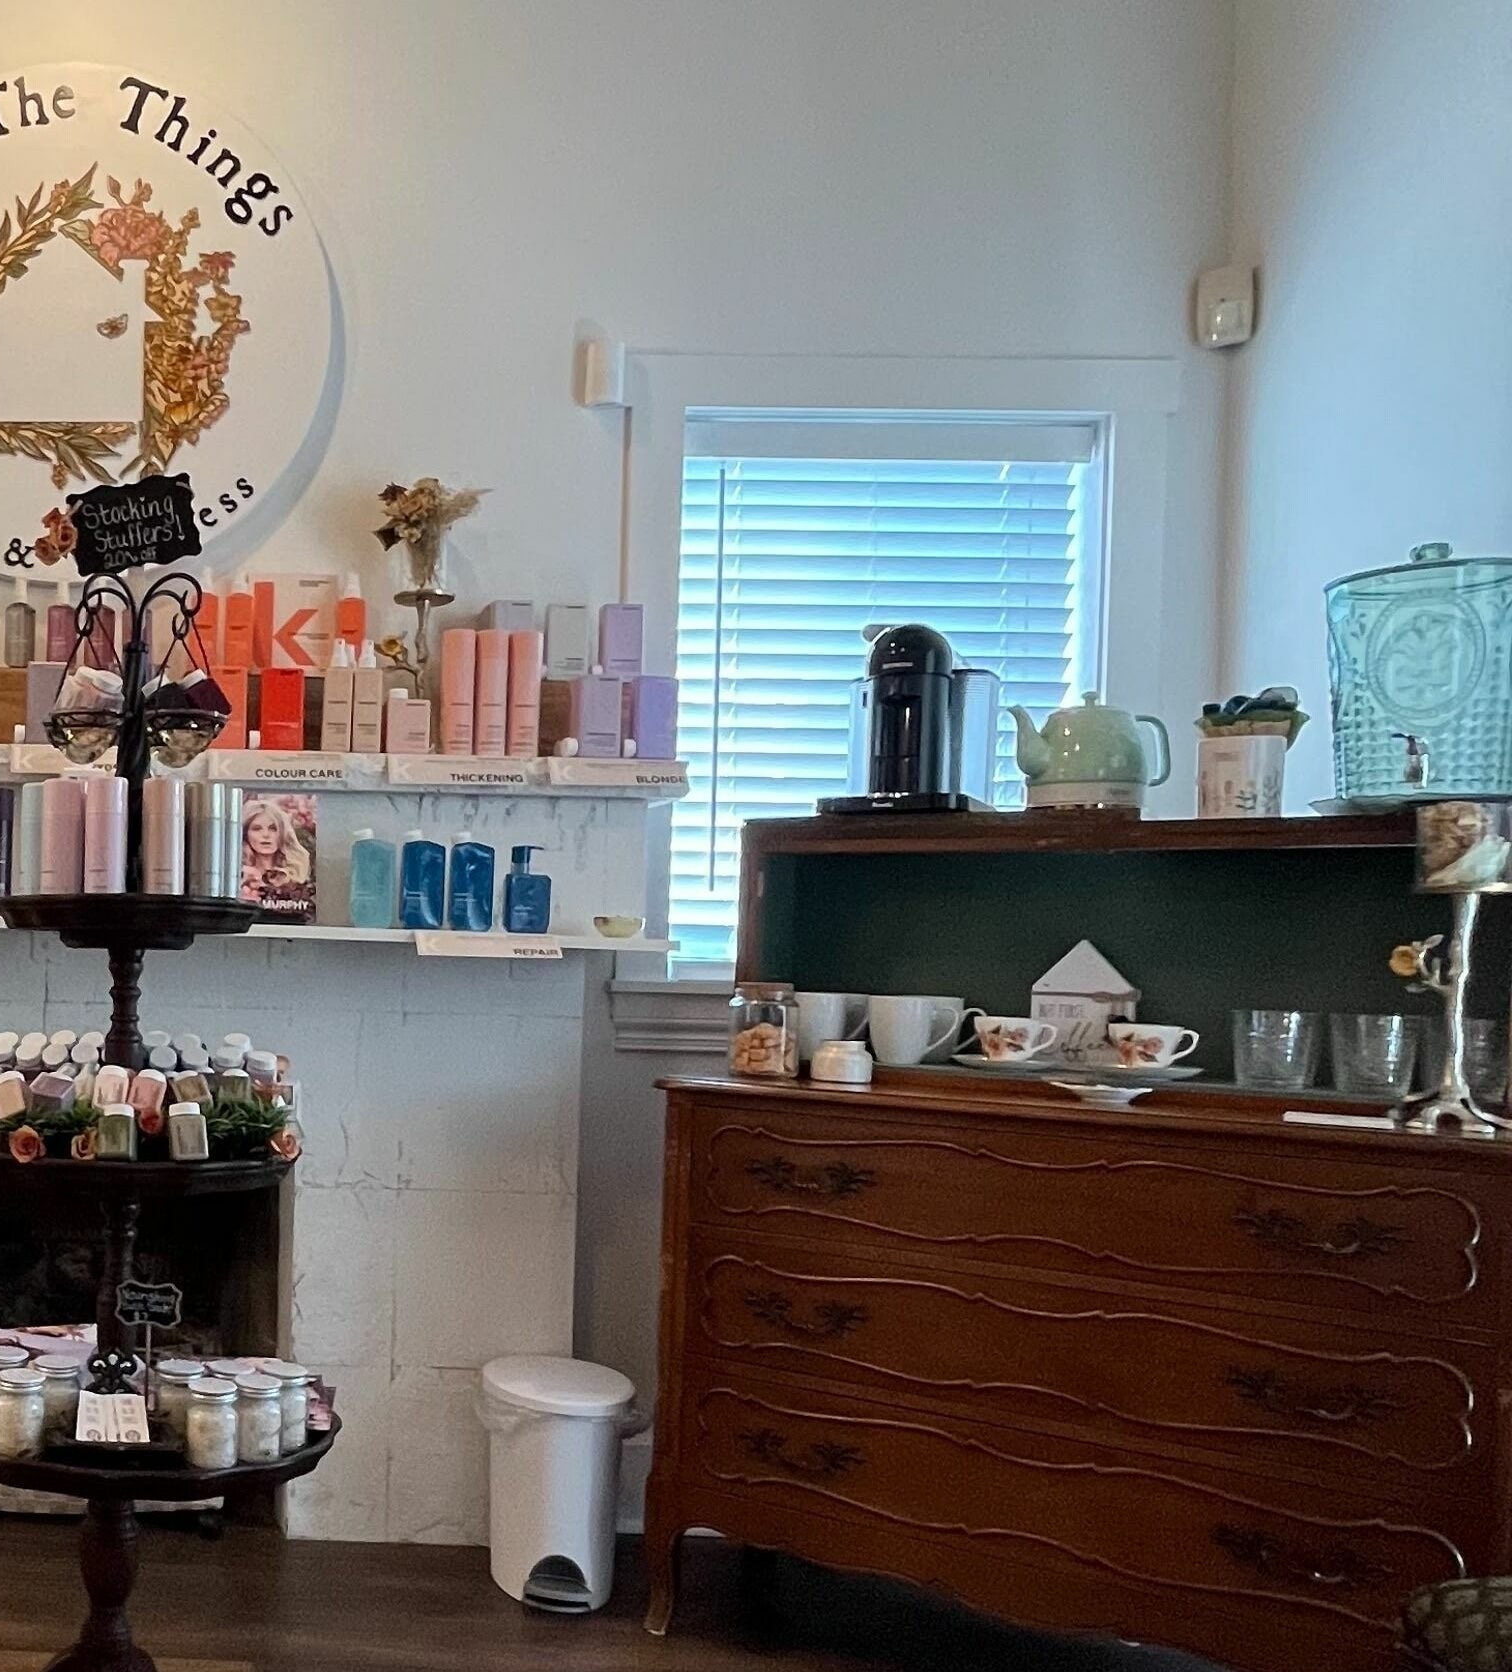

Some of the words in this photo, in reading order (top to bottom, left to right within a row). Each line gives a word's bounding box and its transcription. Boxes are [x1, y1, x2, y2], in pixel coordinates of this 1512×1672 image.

[120, 76, 294, 236] Things
[82, 495, 175, 530] Stocking
[3, 537, 36, 569] &
[255, 768, 306, 779] COLOUR
[309, 769, 343, 779] CARE
[449, 773, 524, 784] THICKENING
[513, 948, 560, 957] REPAIR
